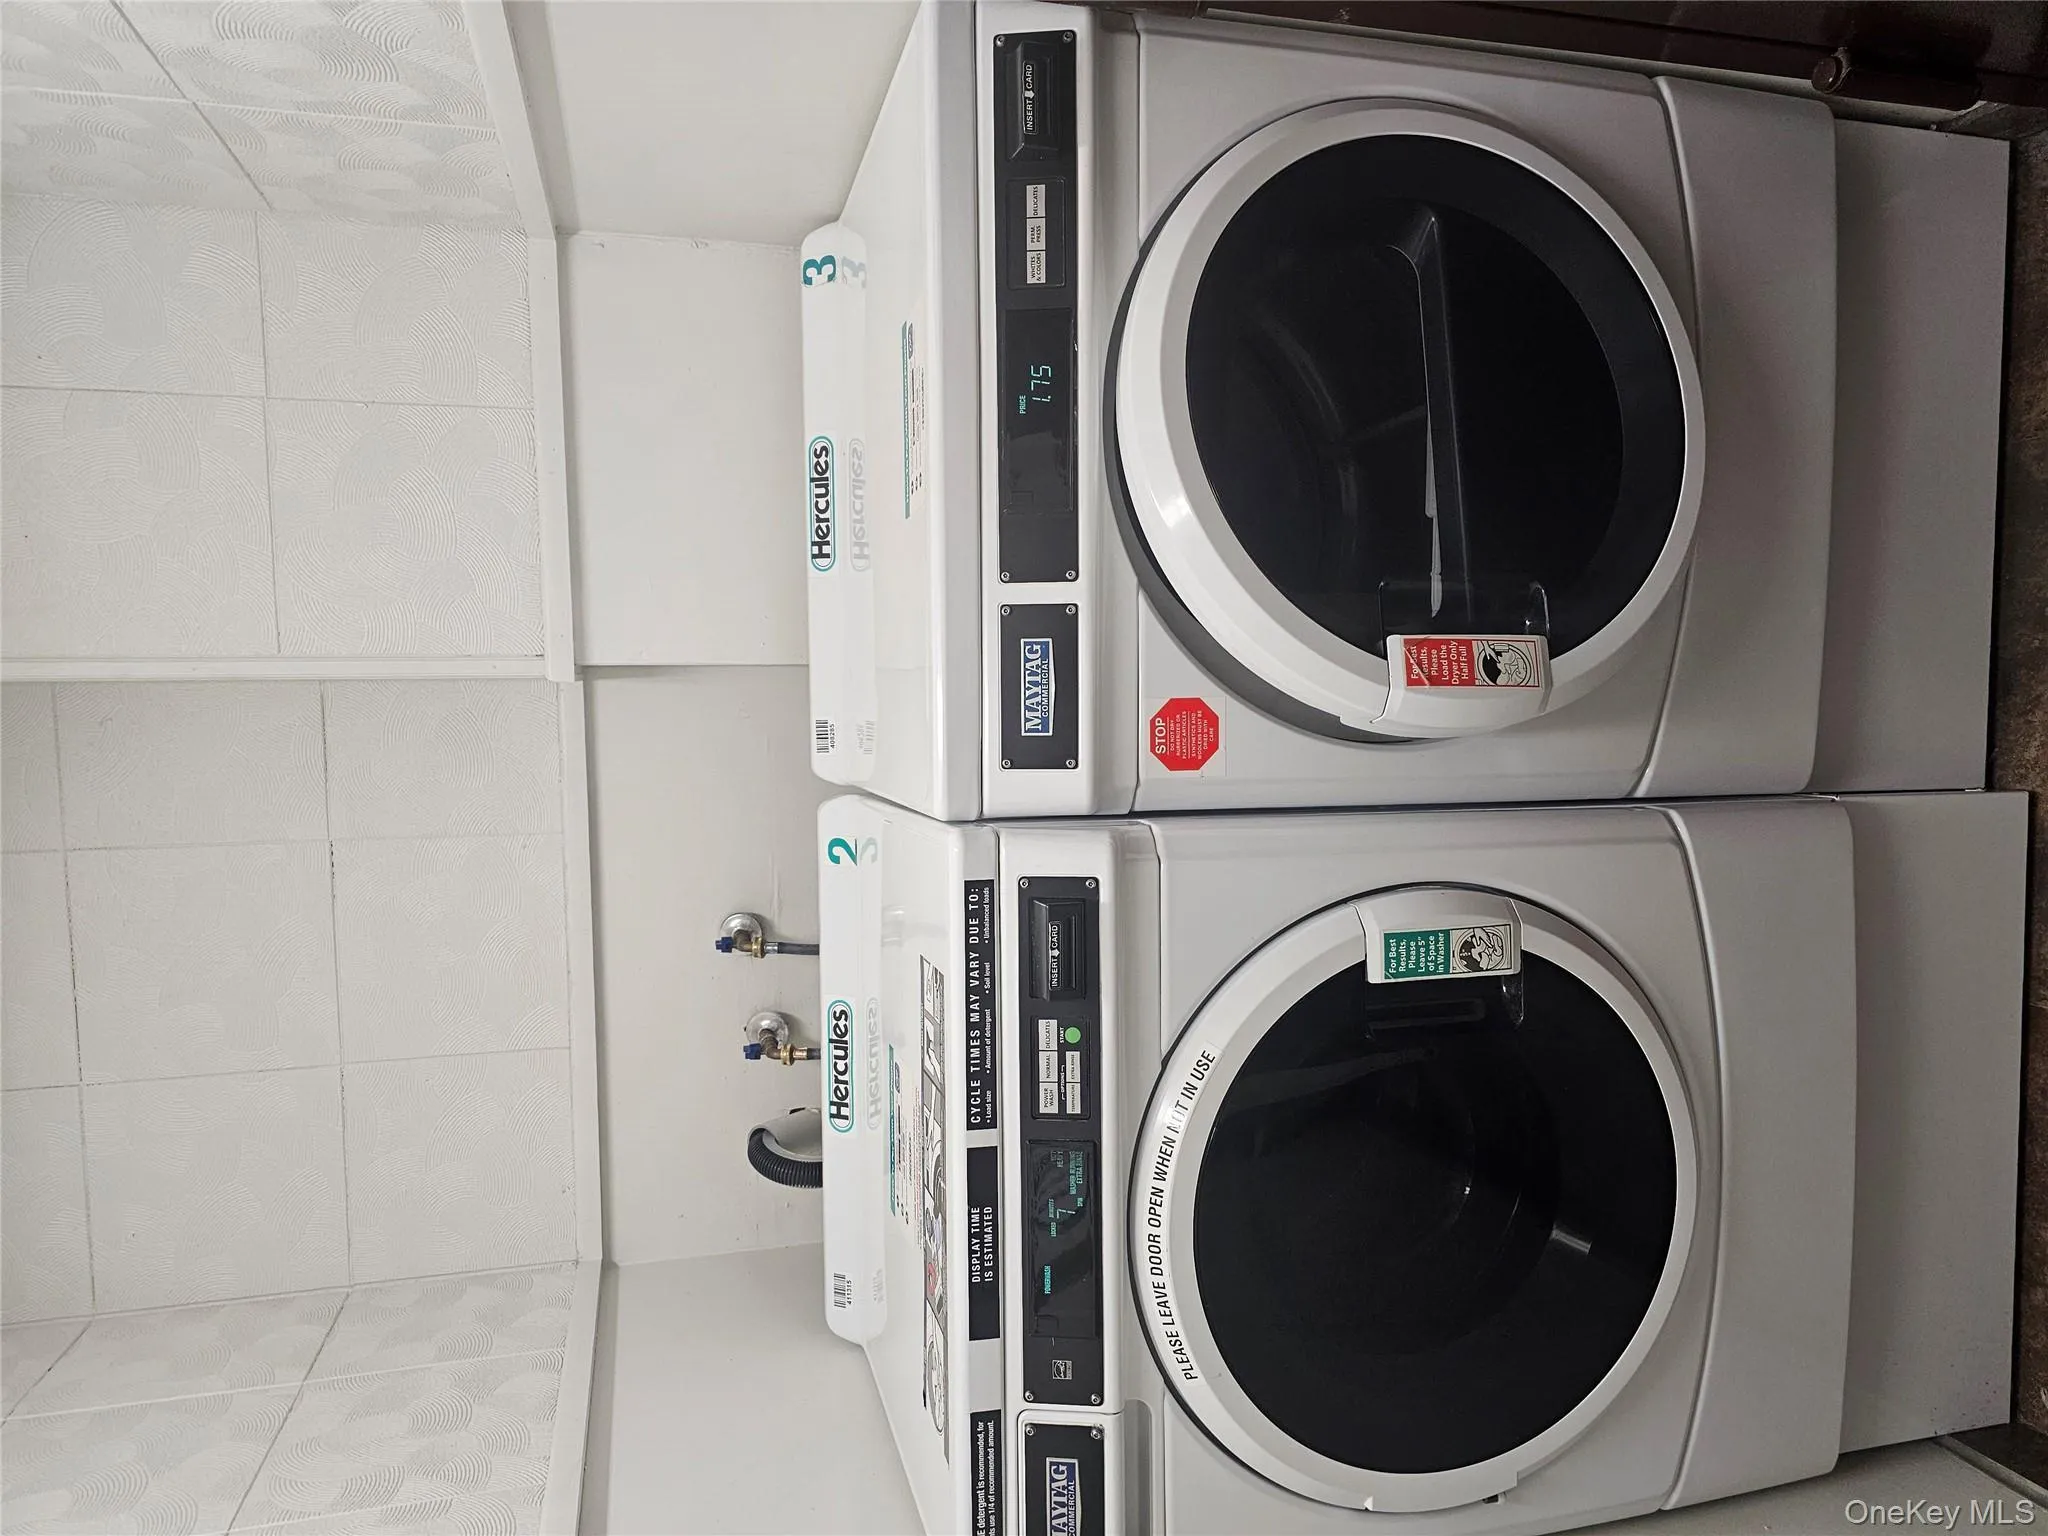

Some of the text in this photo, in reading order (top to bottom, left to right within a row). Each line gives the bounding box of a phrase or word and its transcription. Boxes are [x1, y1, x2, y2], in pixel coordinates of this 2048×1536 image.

[803, 255, 836, 285] 3
[1031, 365, 1051, 402] 1.75
[810, 445, 830, 559] Hercules
[1430, 649, 1438, 675] Please
[1440, 660, 1449, 680] Load
[1450, 640, 1461, 684] Dryer Only
[1461, 663, 1469, 679] Half
[1025, 644, 1042, 731] MAYTAG
[1155, 718, 1166, 754] STOP
[828, 838, 857, 866] 2
[1427, 936, 1437, 971] of Space
[969, 888, 980, 1123] CYCLE TIMES MAY VARY DUE TO:
[828, 1008, 849, 1120] Hercules
[1057, 1208, 1076, 1218] 7
[1148, 1050, 1216, 1380] PLEASE LEAVE DOOR OPEN WHEN NOT IN USE
[971, 1207, 980, 1282] DISPLAY TIME
[984, 1207, 993, 1282] IS ESTIMATED
[977, 1432, 985, 1480] recommended,
[976, 1490, 987, 1528] detergent
